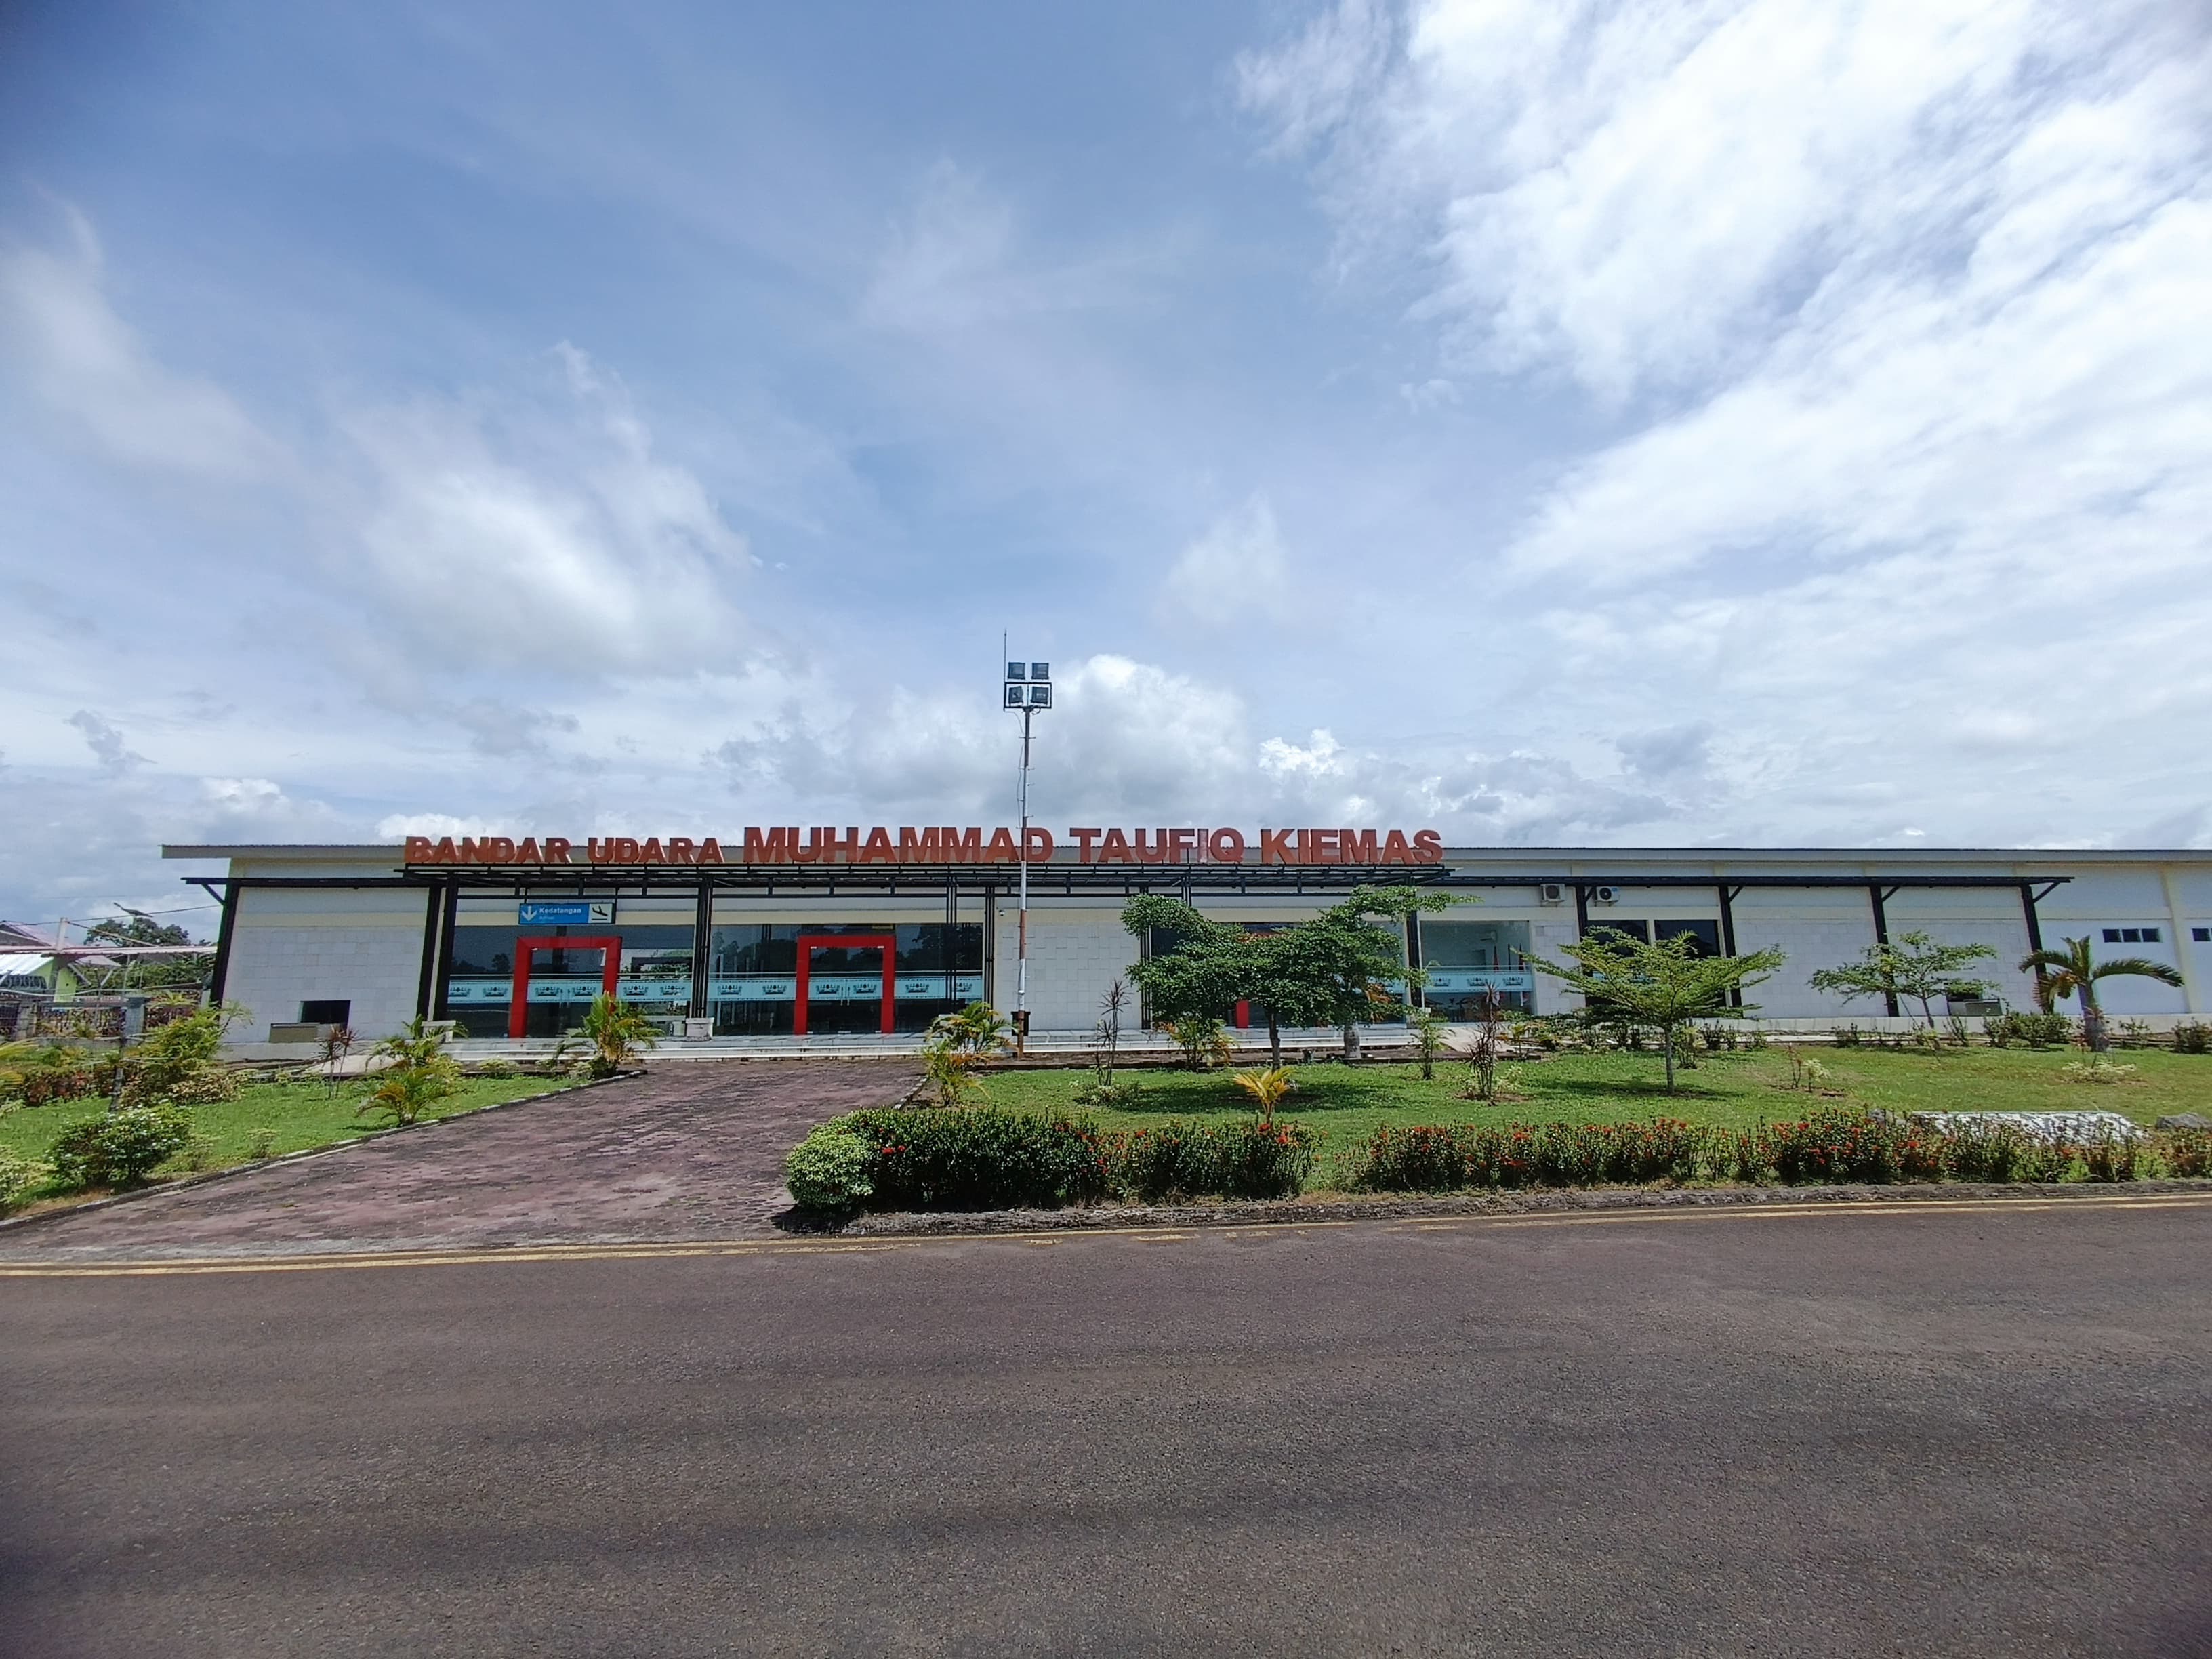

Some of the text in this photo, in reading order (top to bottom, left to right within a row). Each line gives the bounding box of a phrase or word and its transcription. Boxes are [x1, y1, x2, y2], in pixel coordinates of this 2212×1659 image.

[405, 827, 1443, 864] BANDAR UDARA MUHAMMAD TAUFIQ KIEMAS
